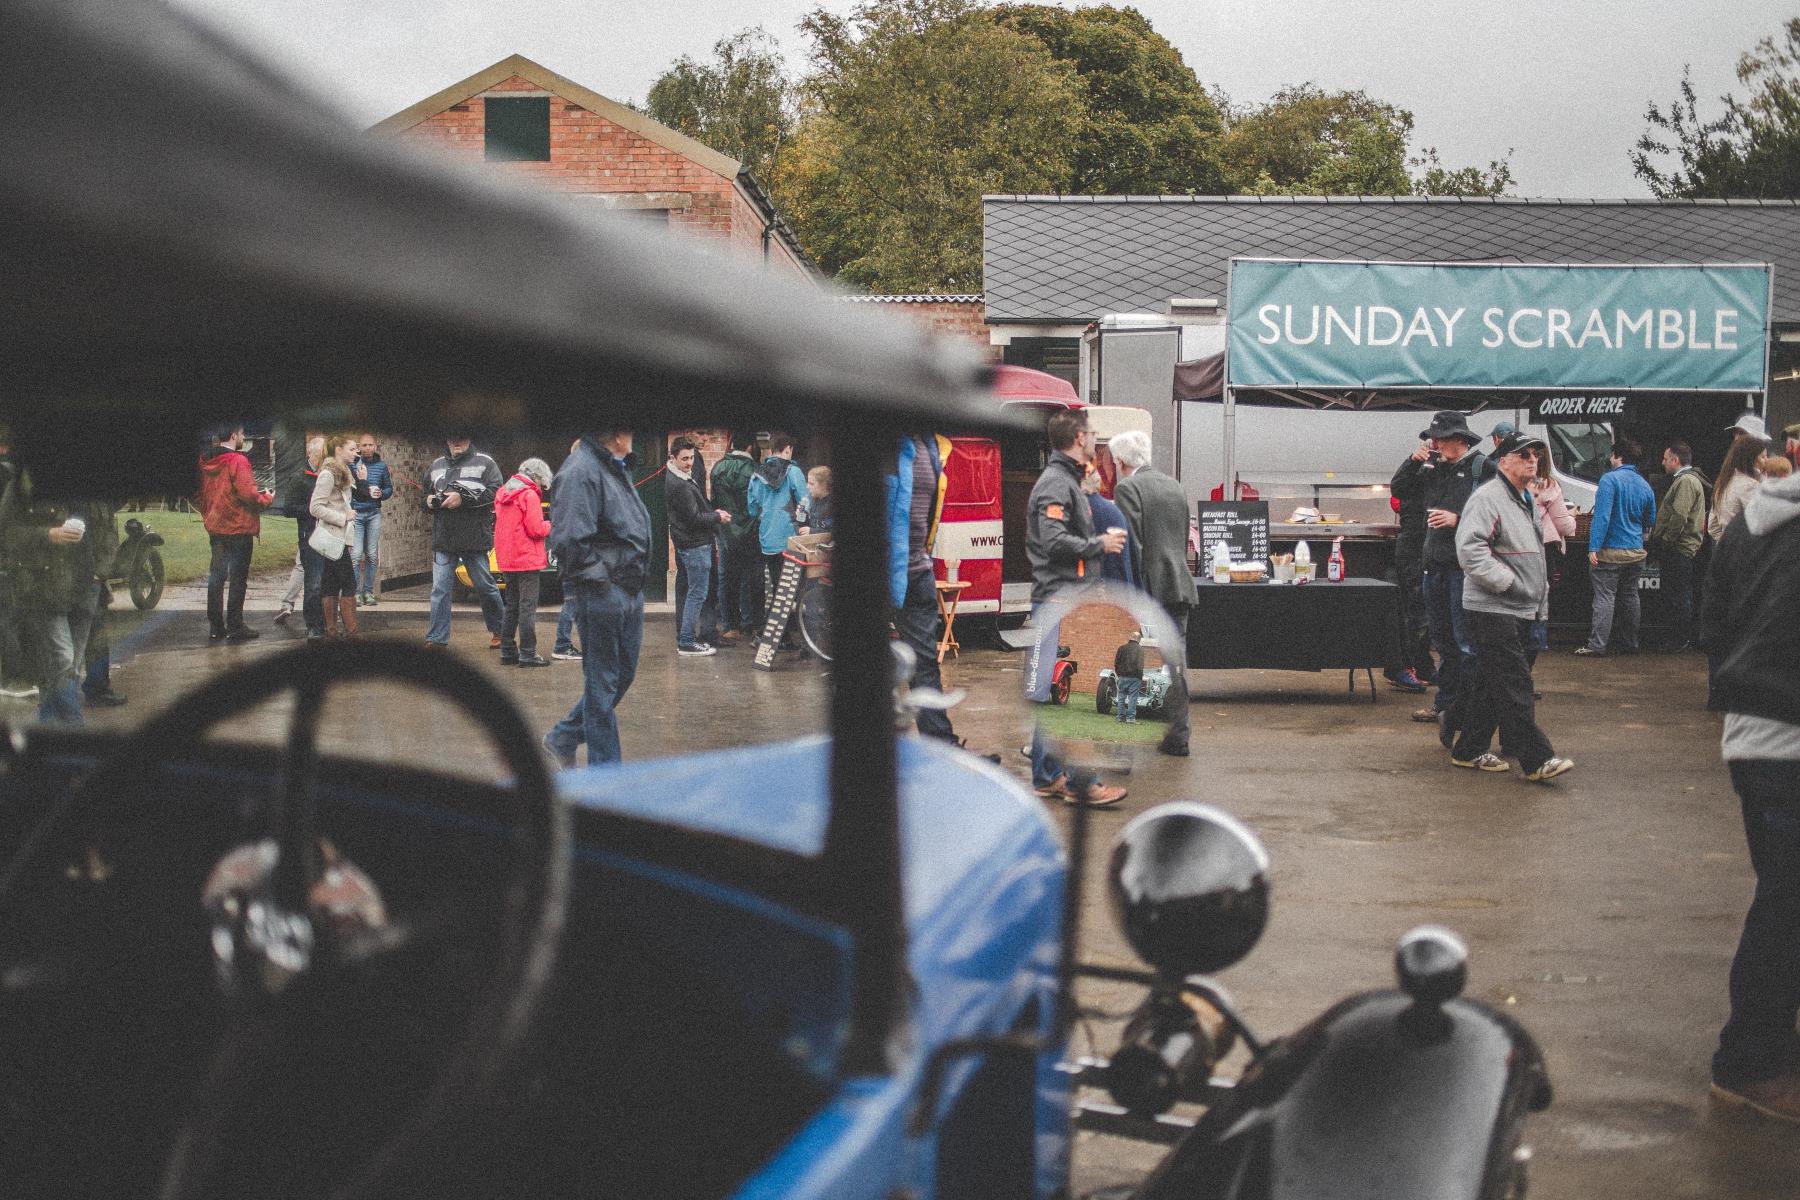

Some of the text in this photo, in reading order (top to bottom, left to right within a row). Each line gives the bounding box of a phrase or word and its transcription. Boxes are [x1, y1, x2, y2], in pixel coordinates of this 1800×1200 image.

[1257, 303, 1738, 350] SUNDAY SCRAMBLE
[1540, 397, 1626, 415] ORDER HERE
